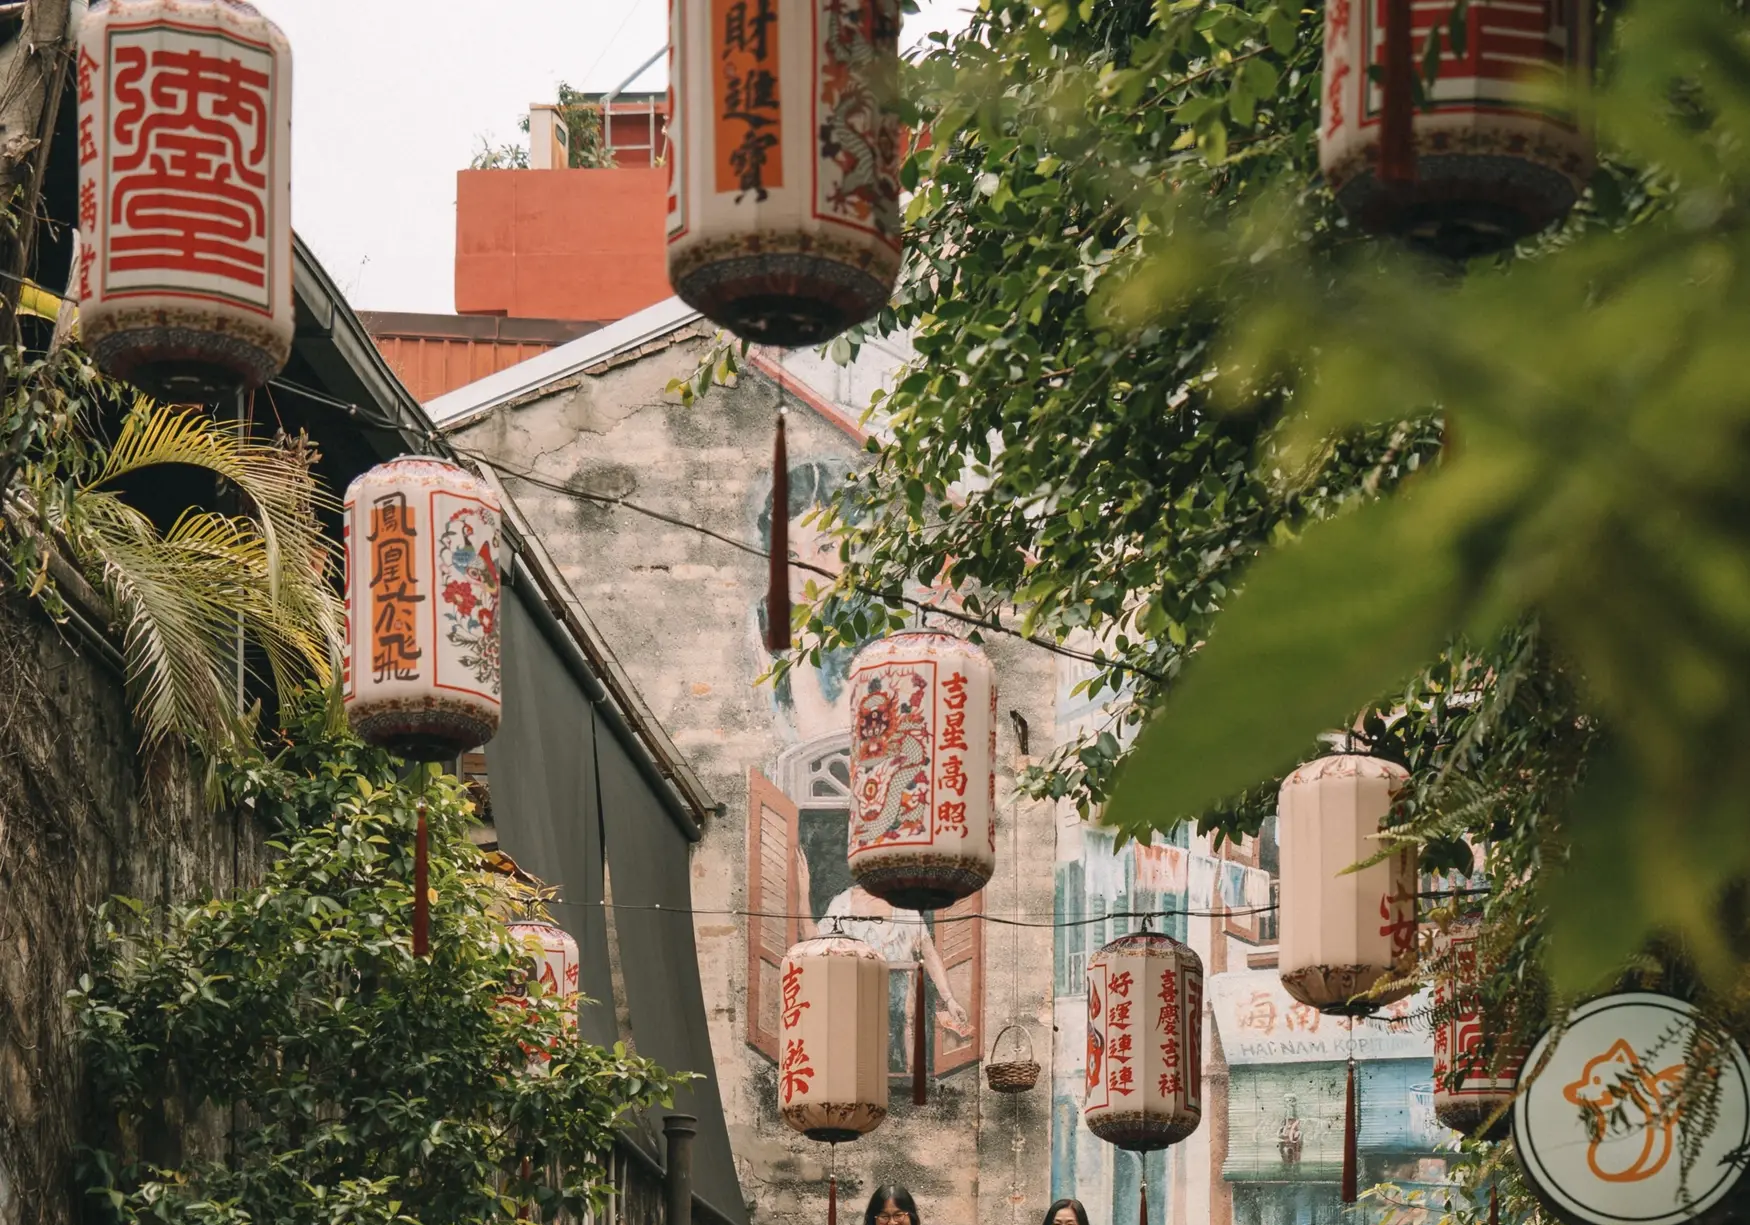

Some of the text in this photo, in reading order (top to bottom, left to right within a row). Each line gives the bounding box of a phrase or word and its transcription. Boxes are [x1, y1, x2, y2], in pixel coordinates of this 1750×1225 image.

[935, 672, 968, 838] 吉星高照
[780, 961, 814, 1104] 喜樂
[1108, 971, 1135, 1097] 好運連連
[1155, 969, 1184, 1098] 喜慶吉祥
